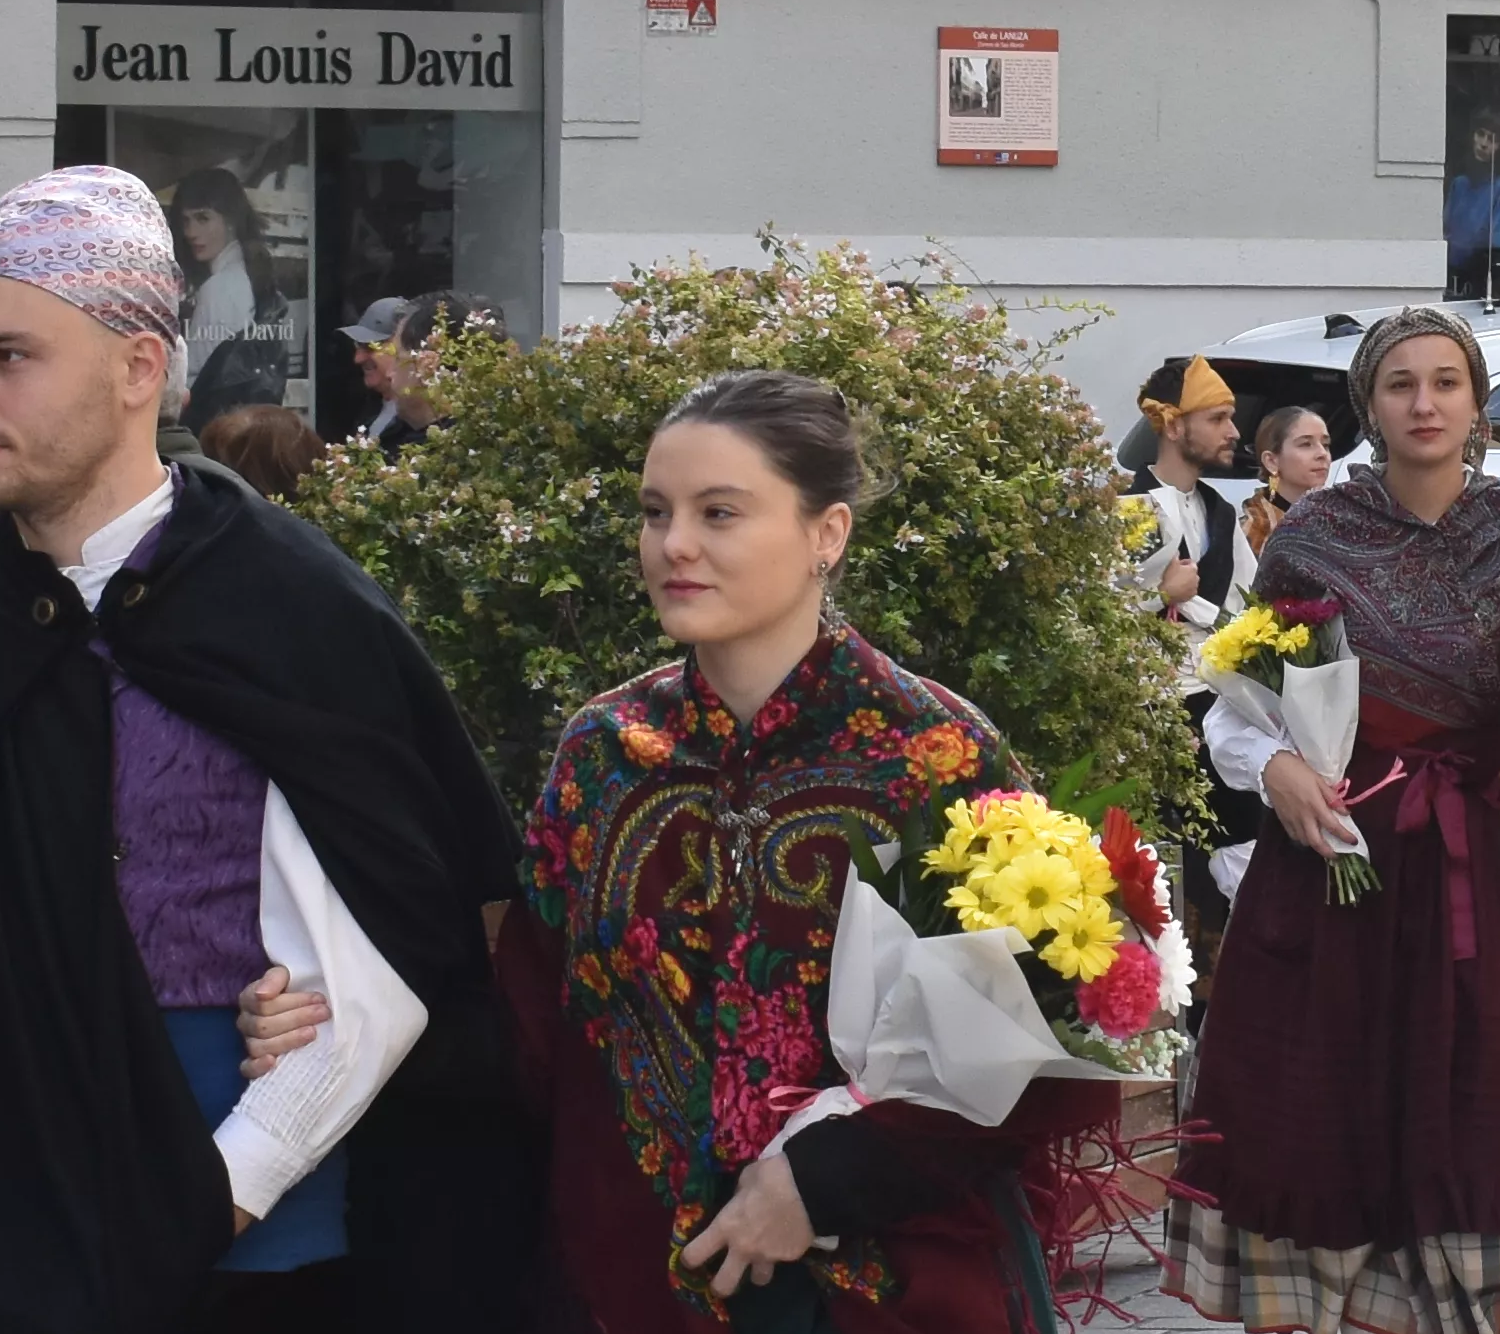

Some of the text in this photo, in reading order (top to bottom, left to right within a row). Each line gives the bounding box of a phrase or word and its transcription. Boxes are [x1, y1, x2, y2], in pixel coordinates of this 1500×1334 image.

[999, 31, 1029, 41] LANUZA
[73, 24, 514, 88] Jean Louis David
[183, 318, 295, 341] Louis David
